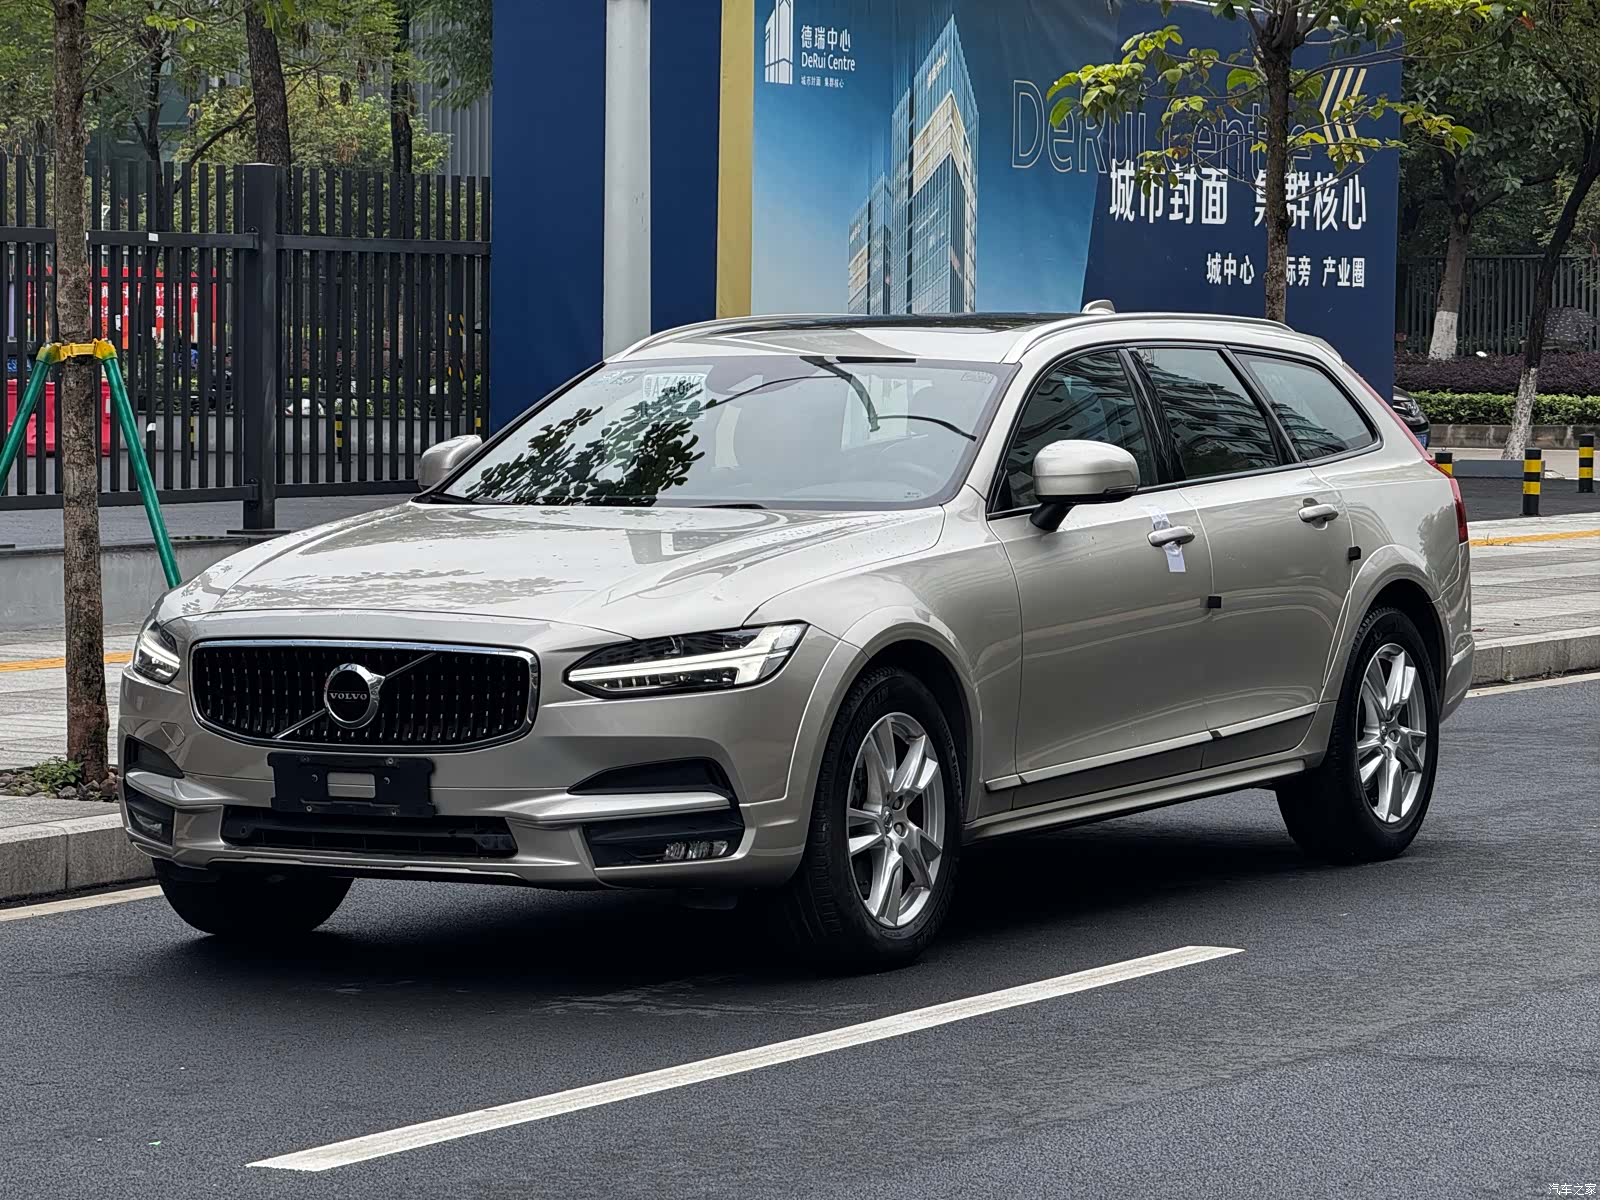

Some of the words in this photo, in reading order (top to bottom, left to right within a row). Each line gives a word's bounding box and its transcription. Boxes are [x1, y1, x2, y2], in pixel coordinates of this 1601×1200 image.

[801, 24, 851, 52] 德瑞中心
[801, 51, 826, 69] DeRui
[828, 53, 856, 72] Centre
[1162, 97, 1312, 184] Cente
[1109, 158, 1228, 225] 城市封面
[1206, 252, 1255, 286] 城中心
[1322, 256, 1365, 288] 产业圈
[329, 692, 368, 700] VOLVO
